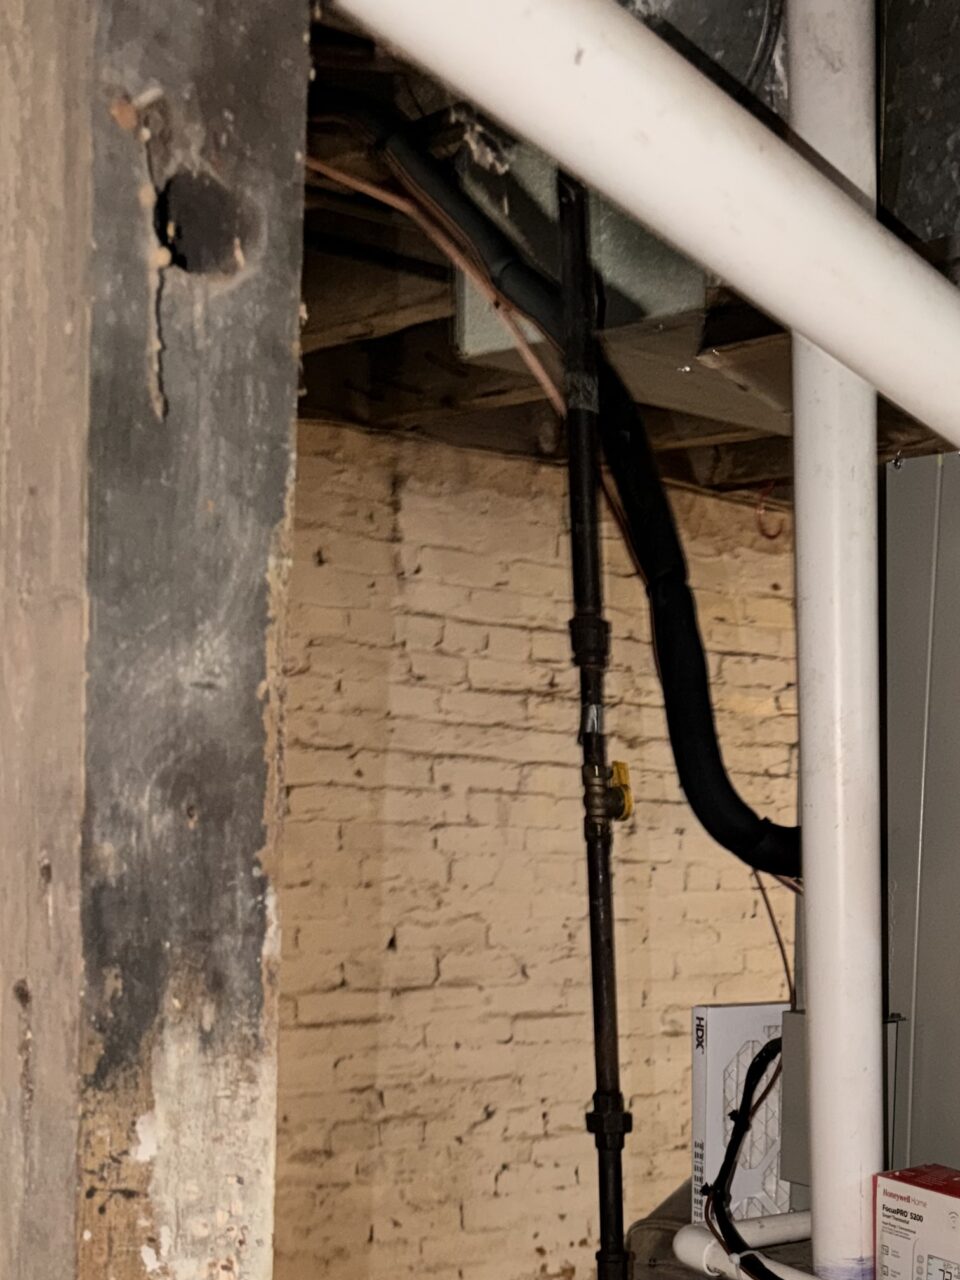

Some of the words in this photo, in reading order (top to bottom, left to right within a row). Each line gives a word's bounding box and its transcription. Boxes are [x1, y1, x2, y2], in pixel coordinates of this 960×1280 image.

[695, 1016, 704, 1050] HDX
[882, 1188, 911, 1203] Honeywell
[882, 1203, 908, 1218] FocusPRO
[909, 1211, 924, 1223] S200
